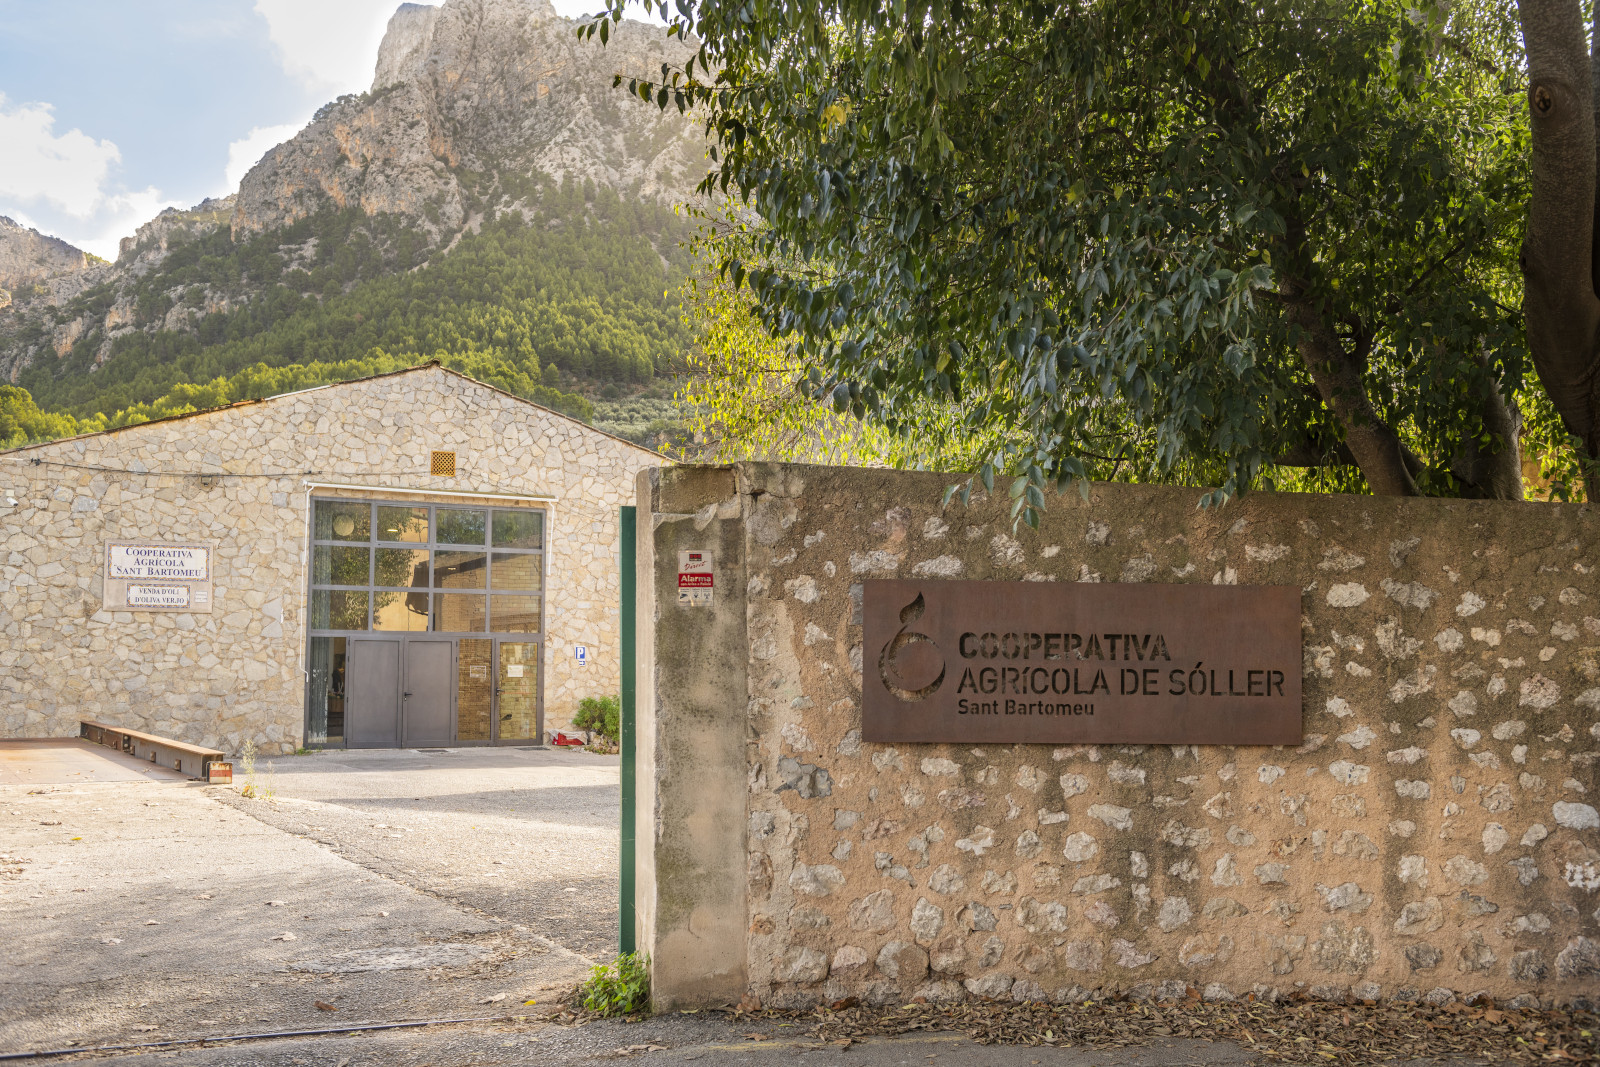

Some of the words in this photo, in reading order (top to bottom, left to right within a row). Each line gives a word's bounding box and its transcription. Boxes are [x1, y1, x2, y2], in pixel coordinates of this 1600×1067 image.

[126, 547, 192, 558] COOPERATIVA
[134, 557, 185, 567] AGRÍCOLA
[958, 631, 1172, 662] COOPERATIVA
[1120, 667, 1160, 696] DE
[1168, 661, 1286, 697] SÓLLER
[957, 699, 999, 716] Sant
[1004, 699, 1095, 716] Bartomeu
